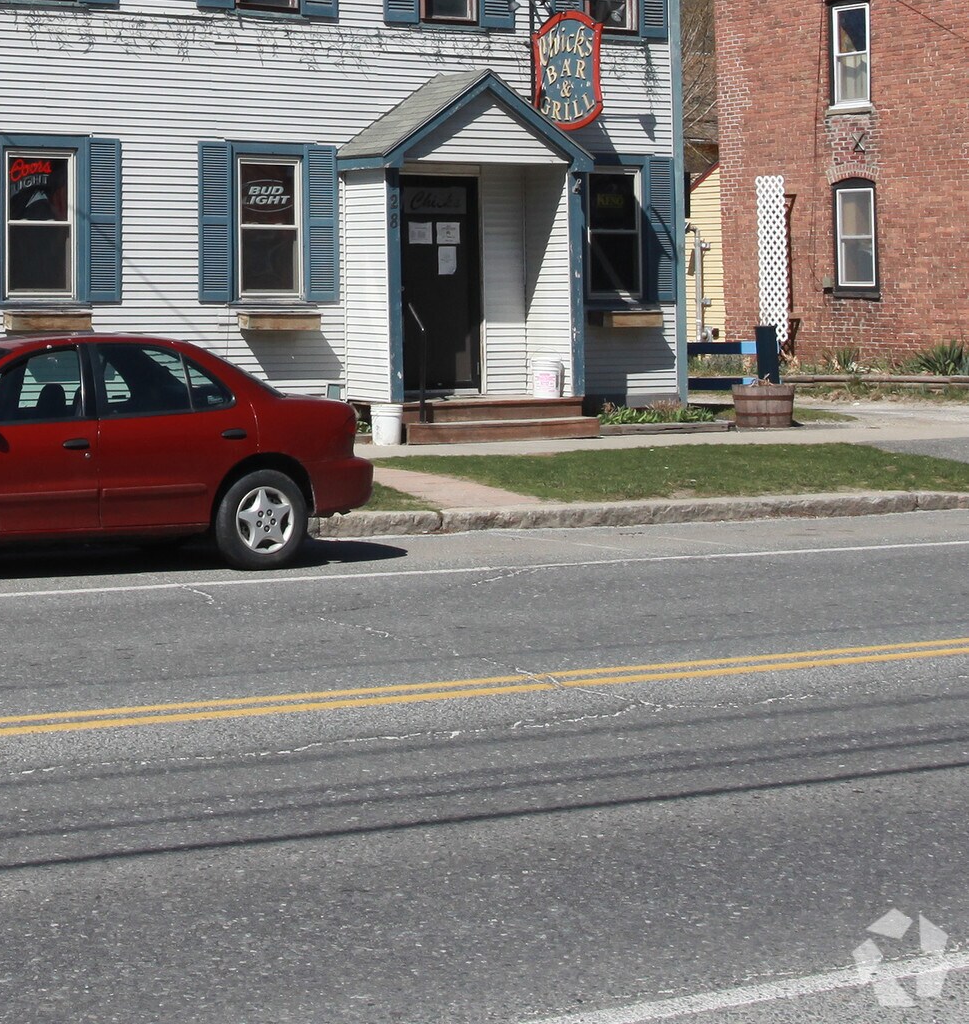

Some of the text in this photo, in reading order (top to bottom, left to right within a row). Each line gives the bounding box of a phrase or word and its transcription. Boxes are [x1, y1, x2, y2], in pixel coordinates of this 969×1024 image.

[545, 58, 586, 85] BAR
[560, 79, 573, 98] &
[540, 91, 594, 121] GRILL
[9, 158, 52, 182] Coors
[248, 185, 284, 195] BUD
